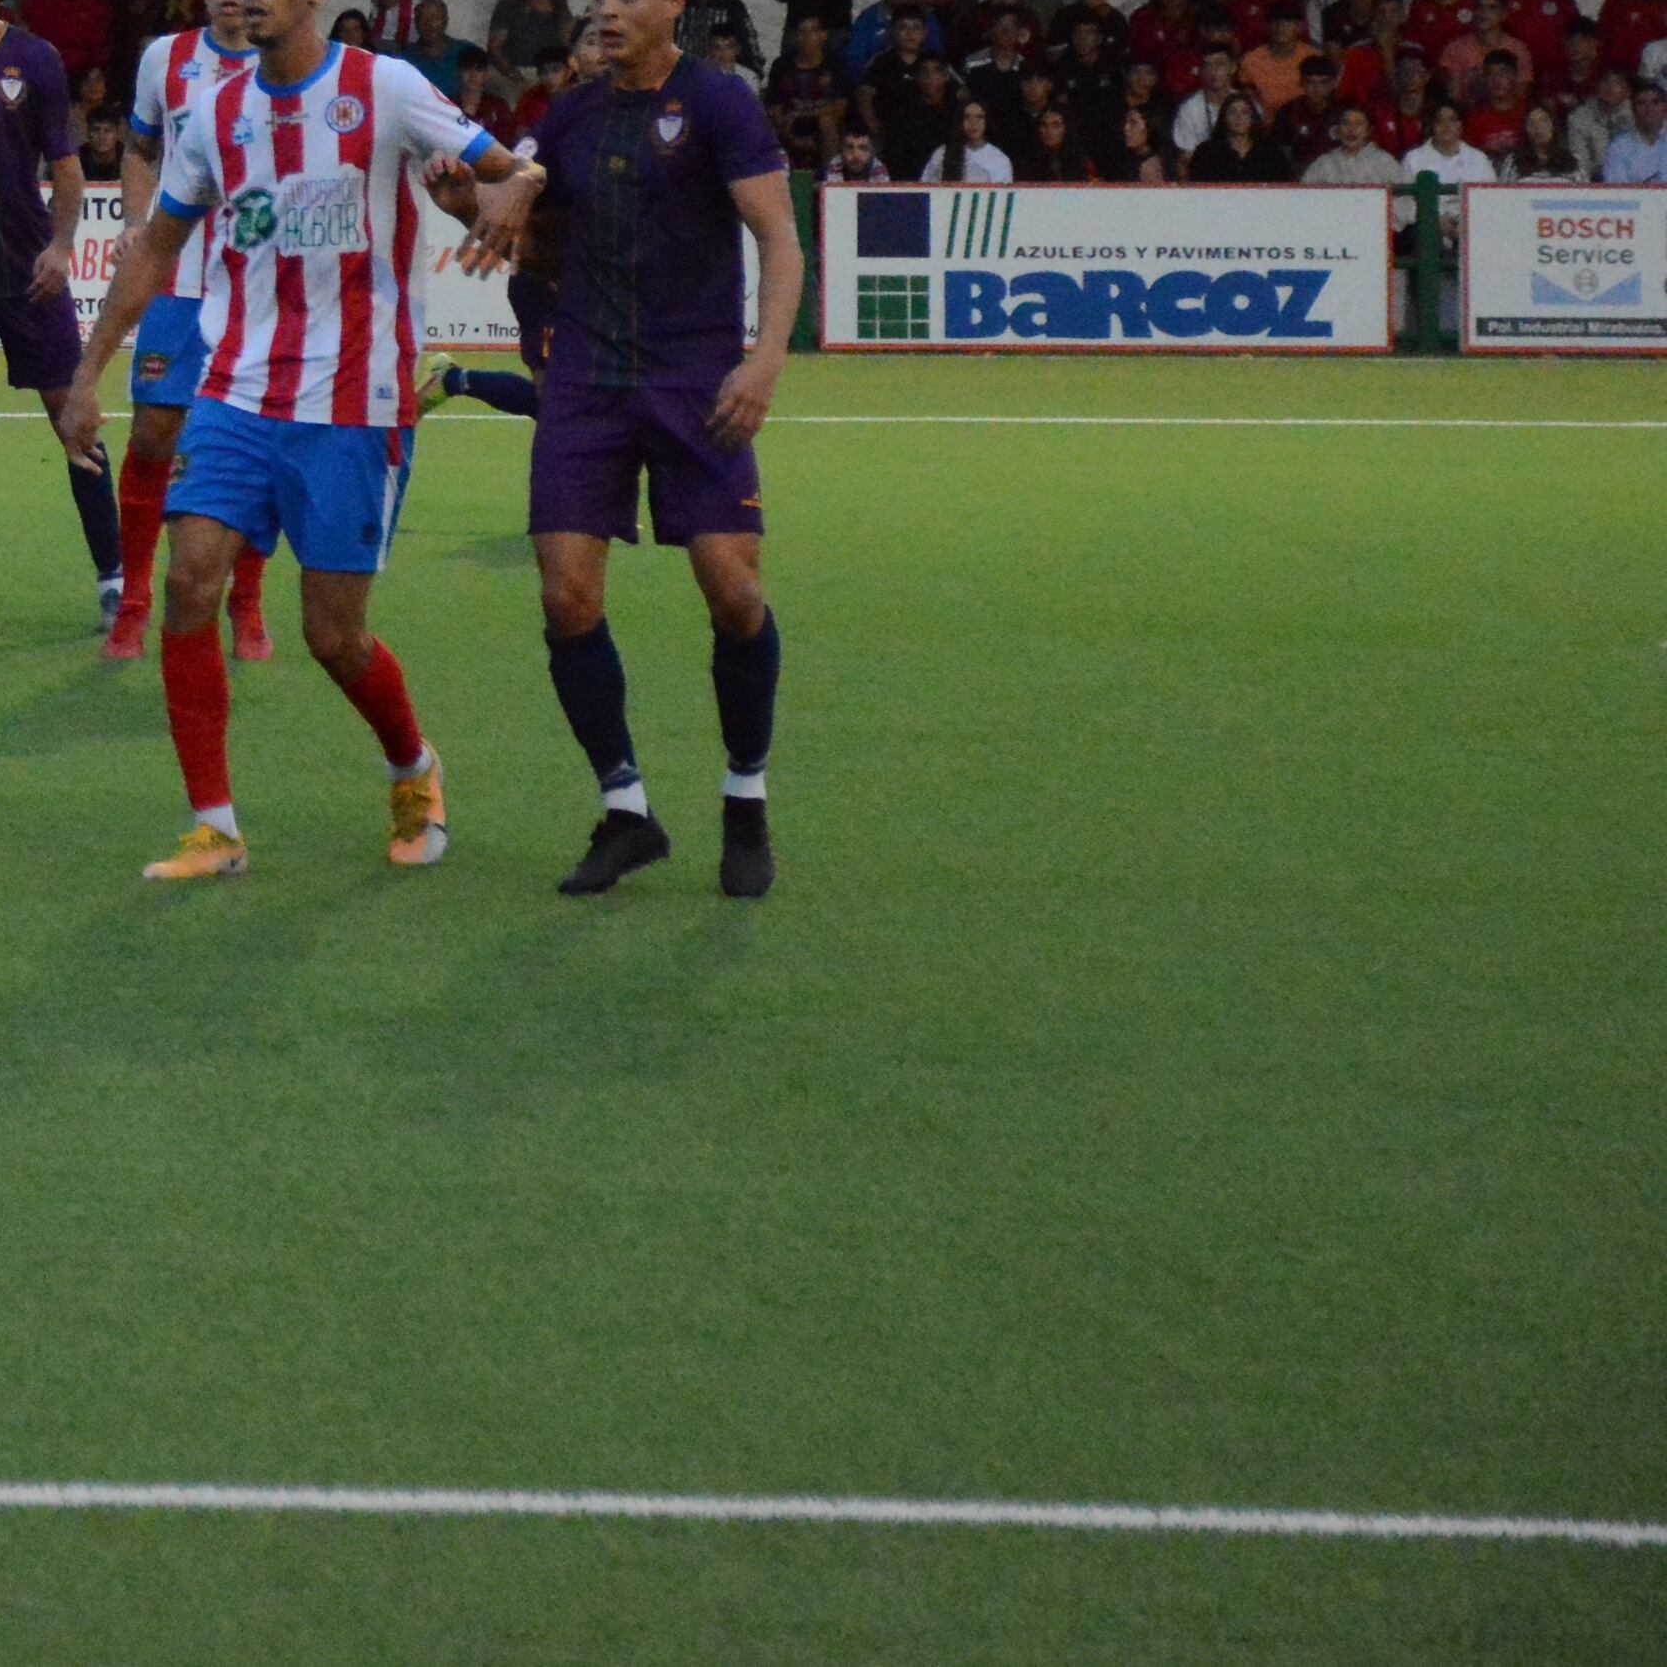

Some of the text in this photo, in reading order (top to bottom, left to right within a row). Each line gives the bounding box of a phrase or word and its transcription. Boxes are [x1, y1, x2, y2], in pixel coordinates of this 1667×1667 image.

[1537, 217, 1635, 239] BOSCH
[1013, 245, 1359, 260] AZULEJOS Y PAVIMENTOS S.L.L.
[1537, 244, 1635, 264] Service
[449, 324, 467, 337] 17
